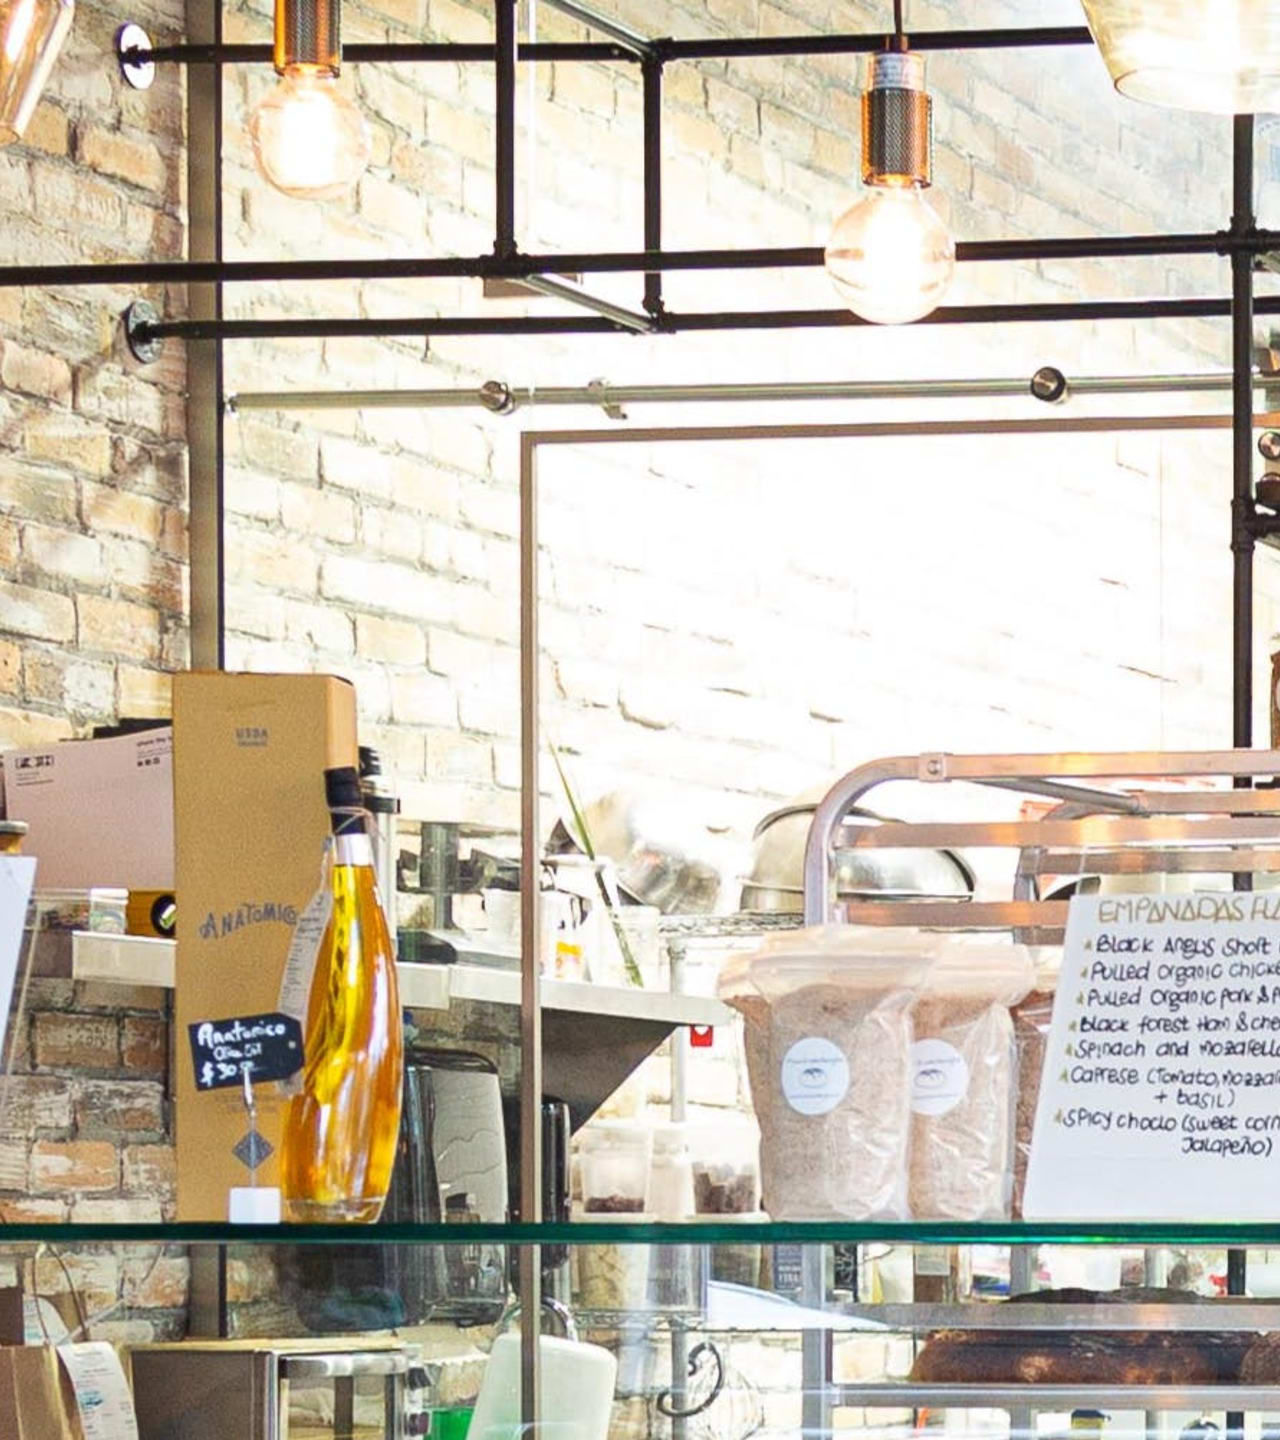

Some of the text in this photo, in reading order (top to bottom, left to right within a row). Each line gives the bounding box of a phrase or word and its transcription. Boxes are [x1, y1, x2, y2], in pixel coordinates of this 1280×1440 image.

[1098, 896, 1245, 925] EMPANADAS
[1096, 934, 1154, 954] Black
[1090, 960, 1151, 982] Pulled
[1087, 985, 1143, 1008] Pulled
[197, 1020, 287, 1049] Anatomico
[1155, 1040, 1190, 1058] and
